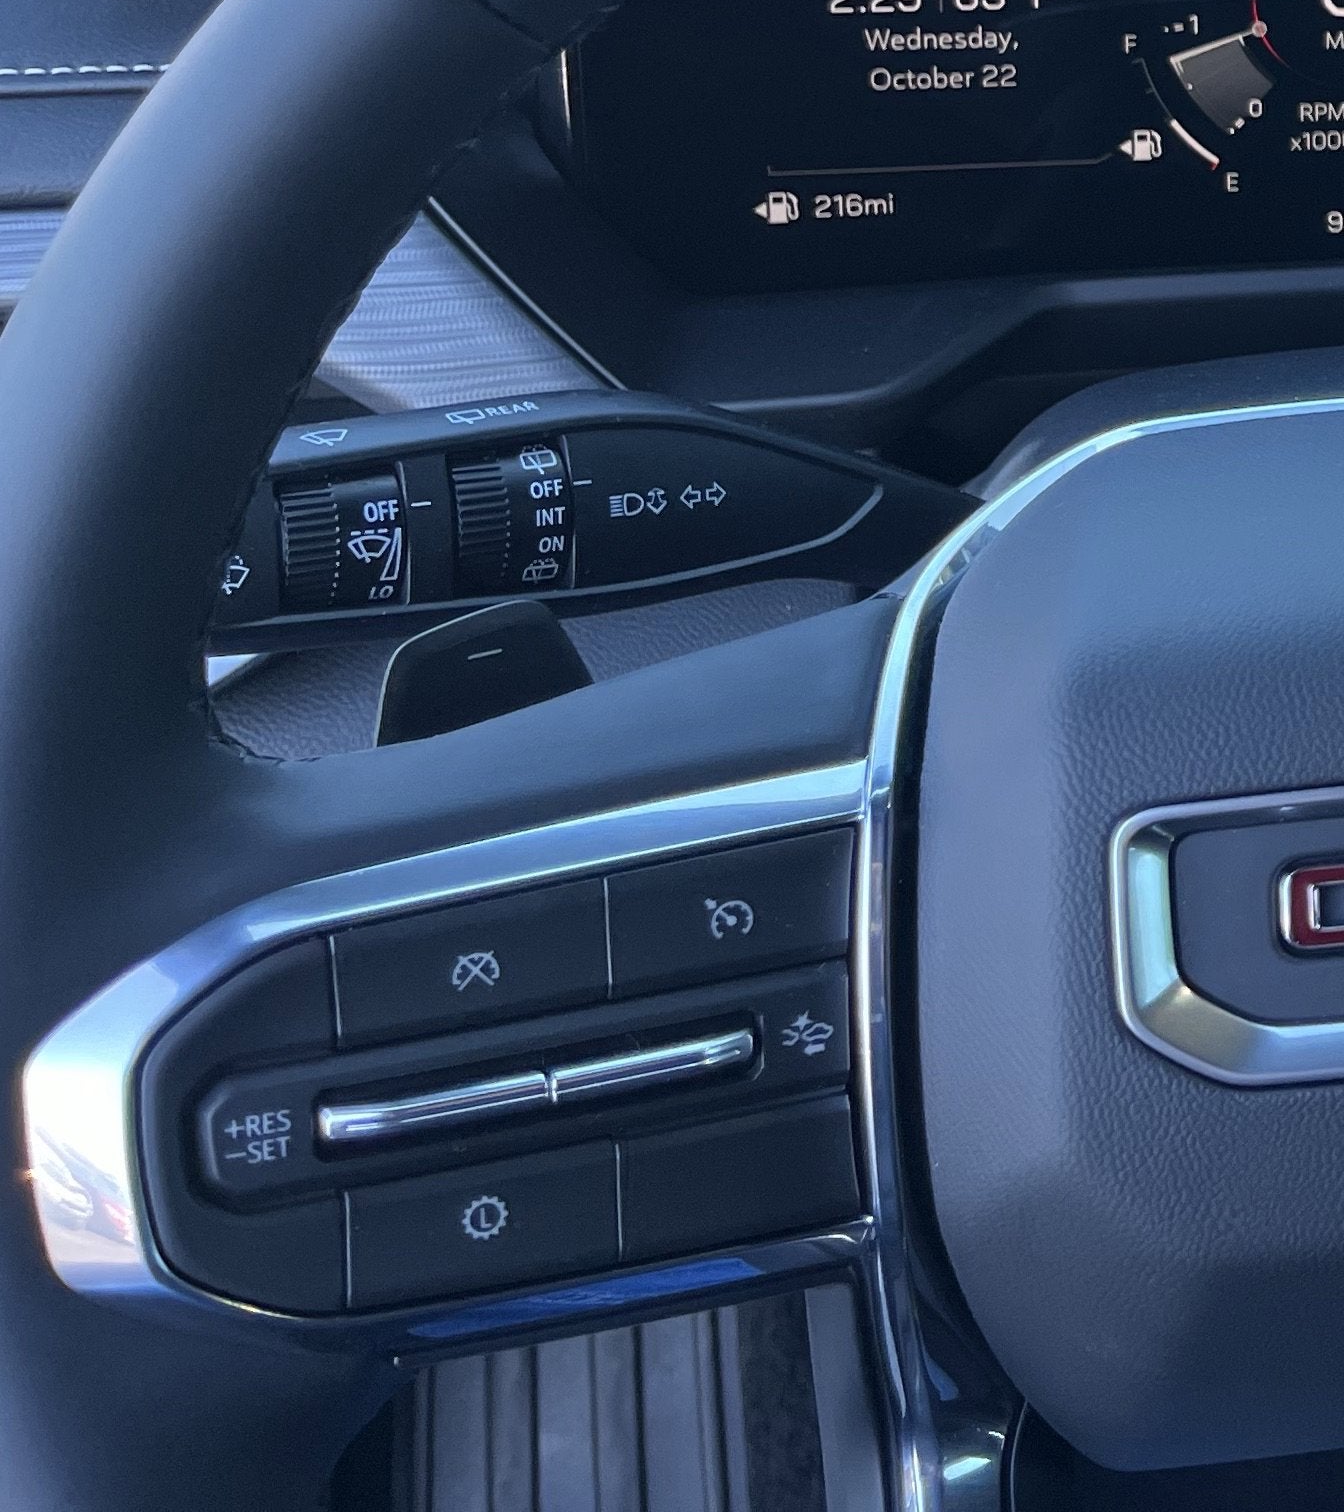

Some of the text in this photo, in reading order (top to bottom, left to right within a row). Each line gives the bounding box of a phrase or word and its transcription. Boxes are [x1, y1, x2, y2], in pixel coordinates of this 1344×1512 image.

[863, 24, 1020, 54] Wednesday,
[1123, 34, 1138, 55] F
[869, 64, 1018, 92] October 22
[1247, 99, 1264, 118] 0
[1226, 172, 1240, 192] E
[813, 193, 895, 219] 216mi
[484, 401, 539, 418] REAR
[529, 478, 564, 499] OFF
[363, 499, 400, 523] OFF
[535, 506, 566, 527] INT
[538, 535, 565, 554] ON
[368, 585, 395, 601] LO
